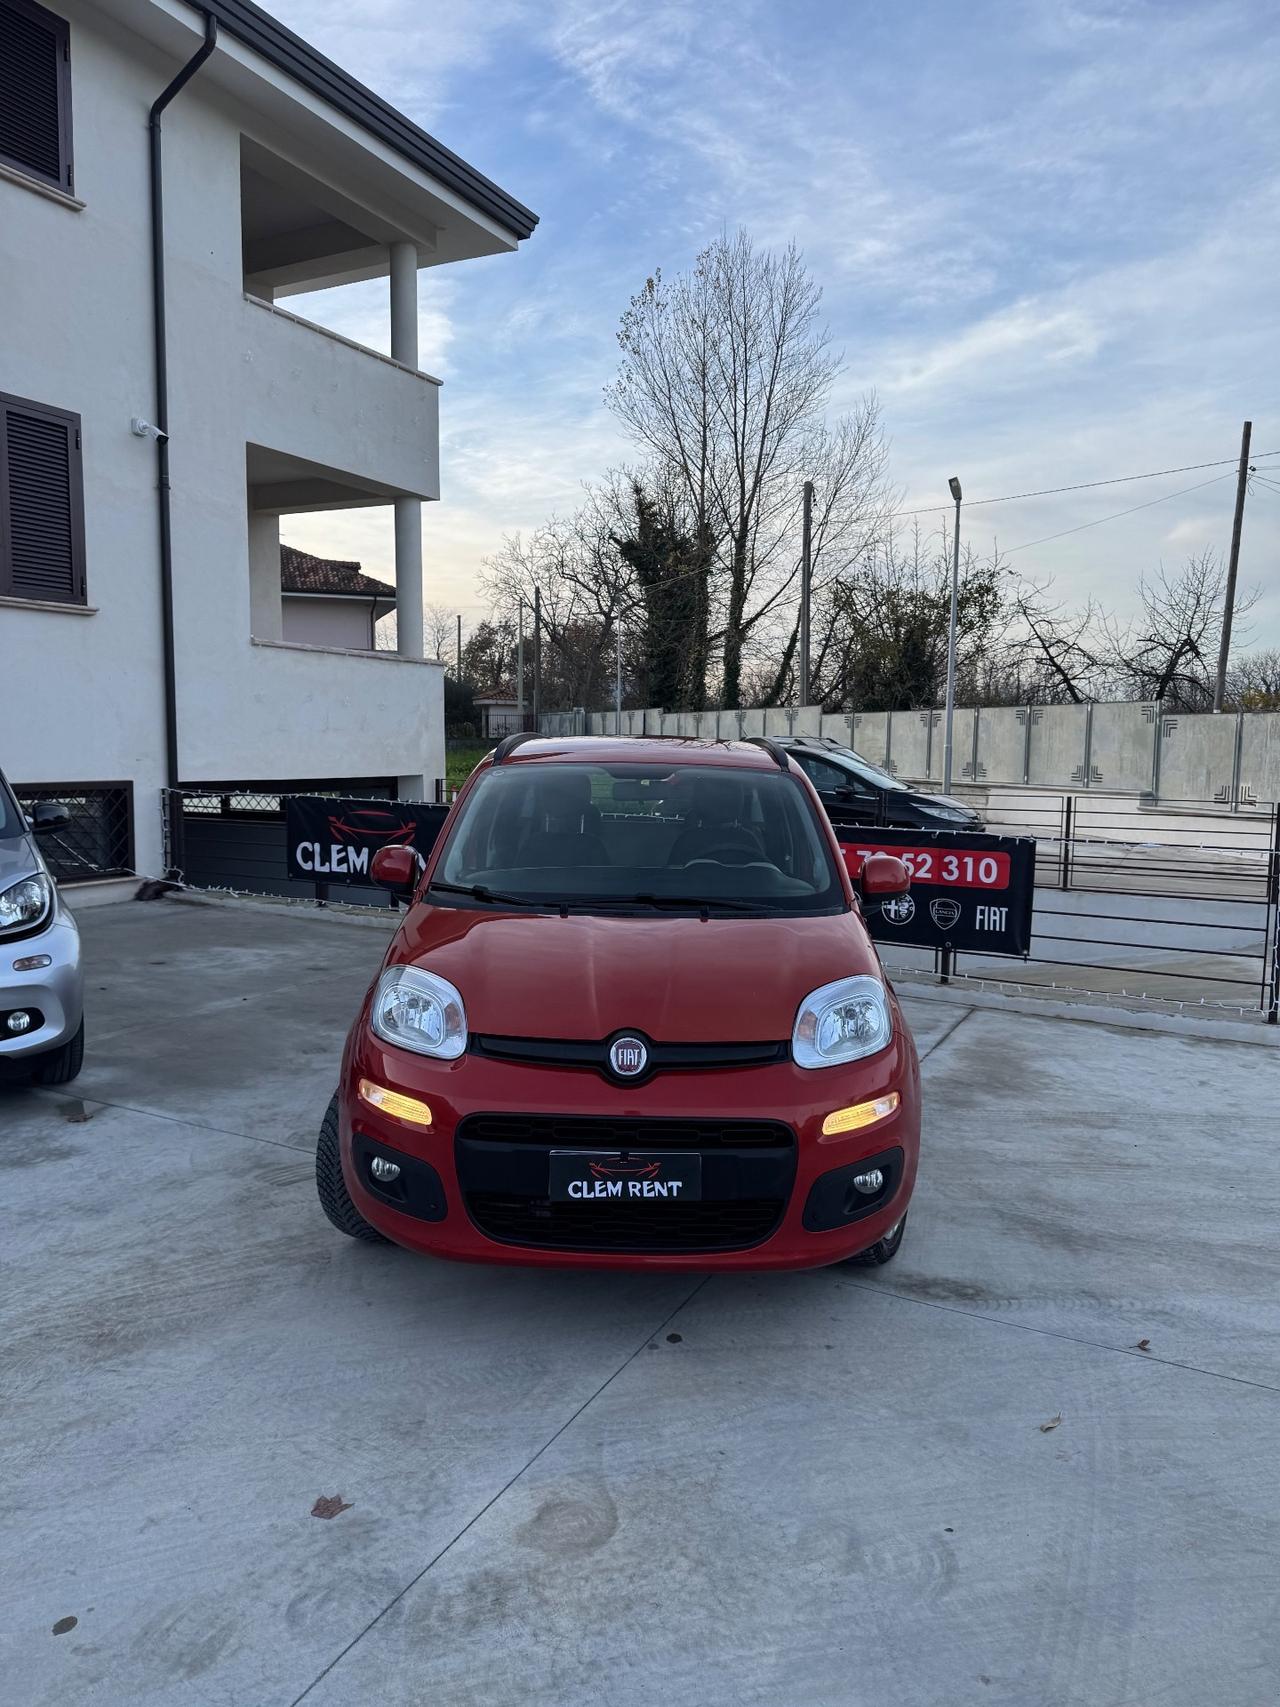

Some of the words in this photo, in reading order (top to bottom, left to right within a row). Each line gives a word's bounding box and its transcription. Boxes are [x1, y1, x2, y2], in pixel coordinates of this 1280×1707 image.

[296, 841, 369, 875] CLEM
[941, 855, 998, 884] 310
[975, 905, 1008, 932] FIAT
[618, 1049, 640, 1066] FIAT
[568, 1181, 622, 1199] CLEM
[628, 1180, 682, 1198] RENT
